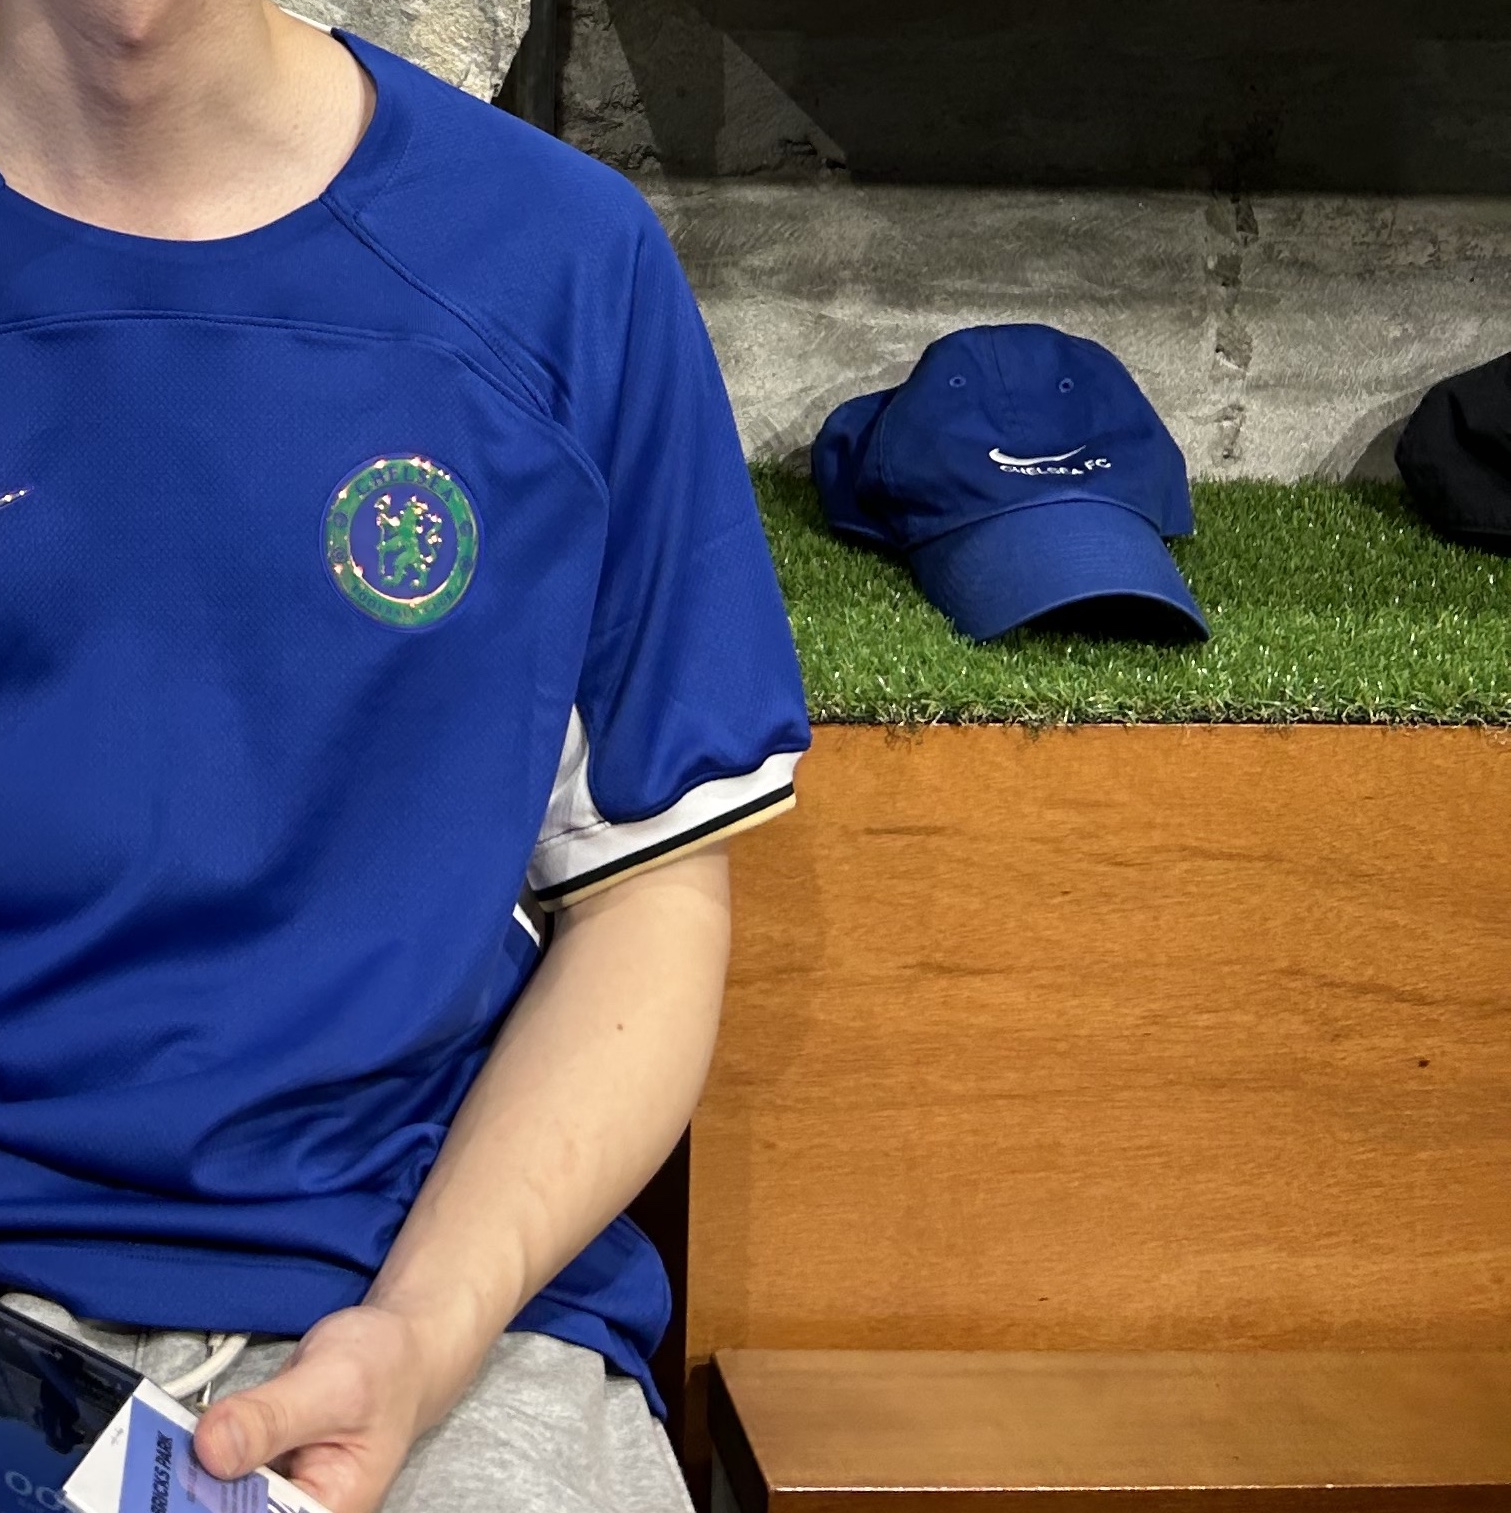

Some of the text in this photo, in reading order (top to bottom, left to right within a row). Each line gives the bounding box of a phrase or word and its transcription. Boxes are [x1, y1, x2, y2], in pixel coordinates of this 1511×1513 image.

[354, 464, 454, 503] CHELSEA
[1084, 458, 1112, 470] FC
[155, 1430, 173, 1470] PARK
